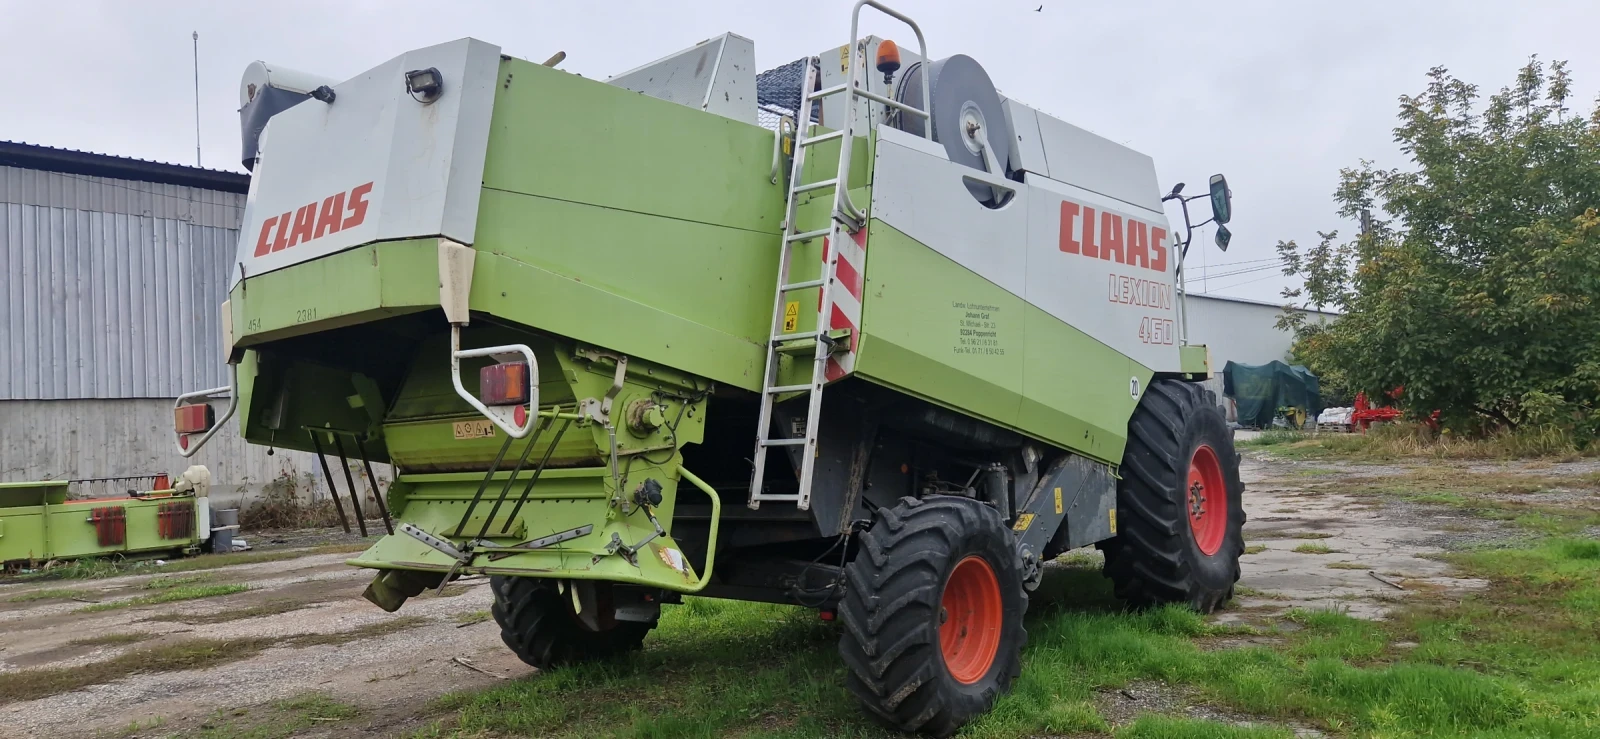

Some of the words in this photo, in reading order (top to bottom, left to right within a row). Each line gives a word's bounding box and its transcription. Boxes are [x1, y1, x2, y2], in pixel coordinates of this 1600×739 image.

[254, 181, 374, 257] CLAAS
[1059, 200, 1166, 272] CLAAS
[1109, 274, 1171, 309] LEXION
[248, 318, 261, 331] 454
[297, 308, 317, 322] 2381
[1139, 317, 1173, 345] 460
[1132, 380, 1138, 396] 20
